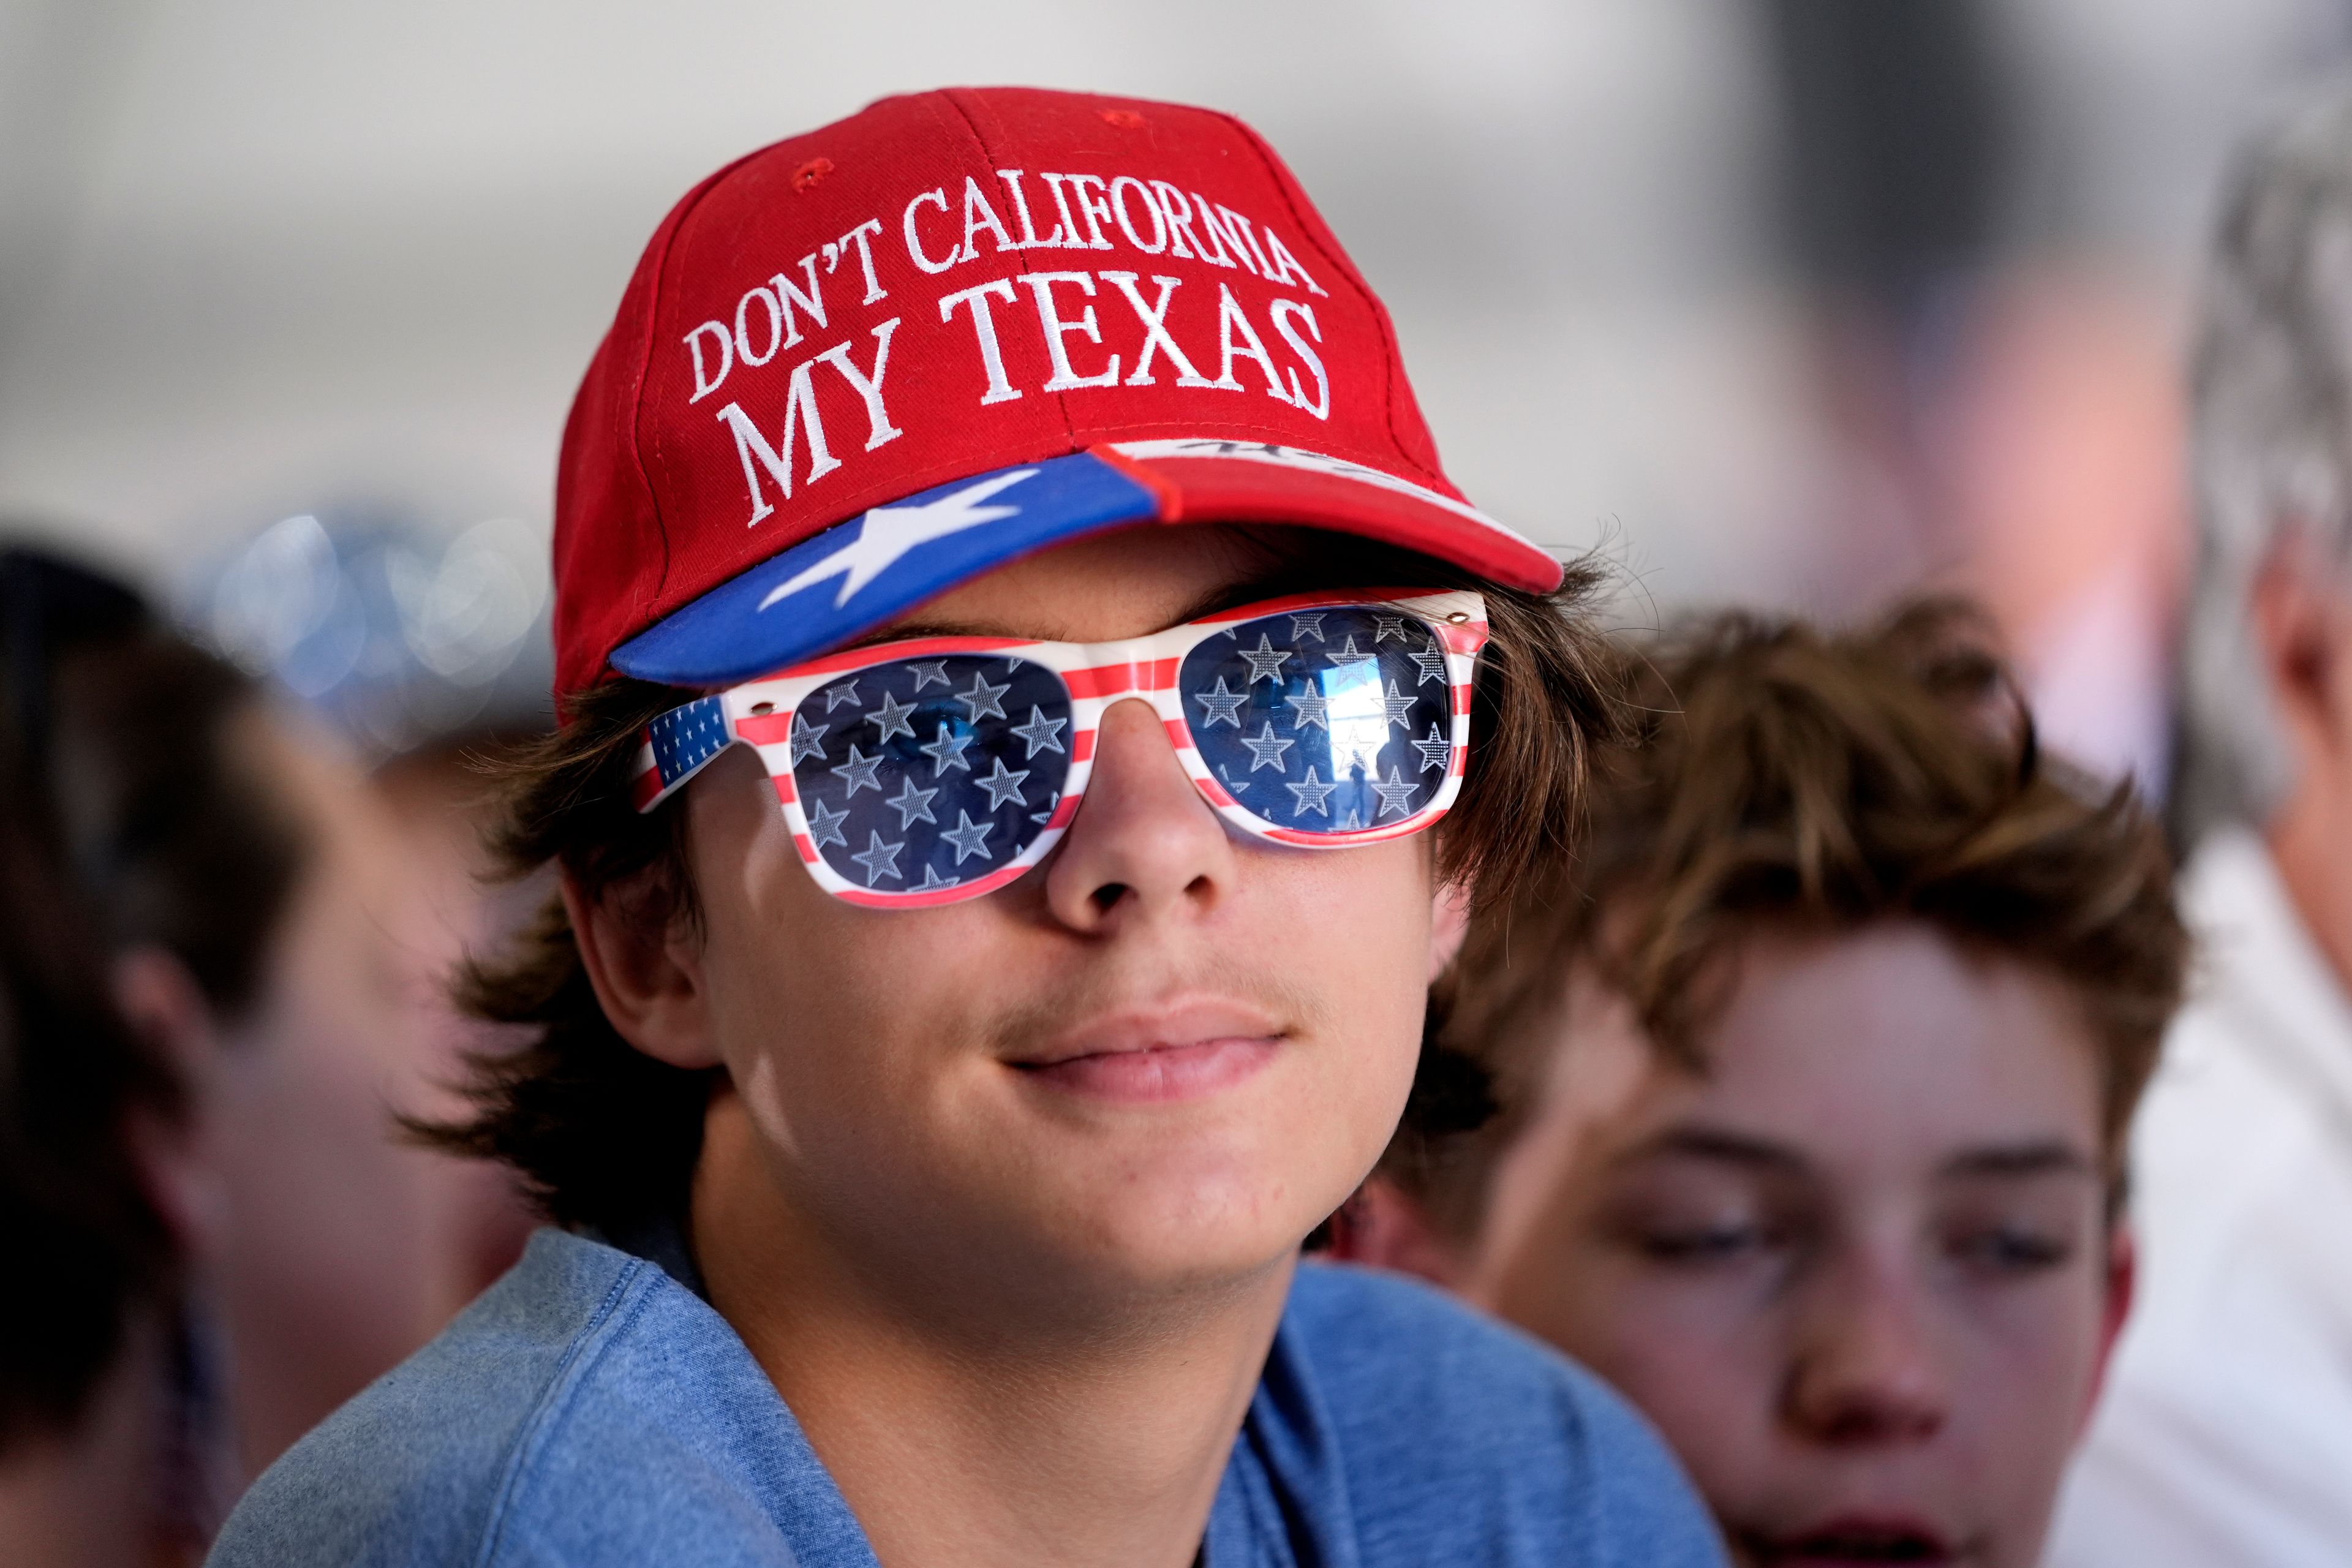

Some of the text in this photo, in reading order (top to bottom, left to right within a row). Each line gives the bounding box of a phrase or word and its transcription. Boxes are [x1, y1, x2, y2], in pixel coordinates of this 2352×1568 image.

[683, 170, 1329, 404] DON'T CALIFORNIA
[717, 271, 1330, 528] MY TEXAS
